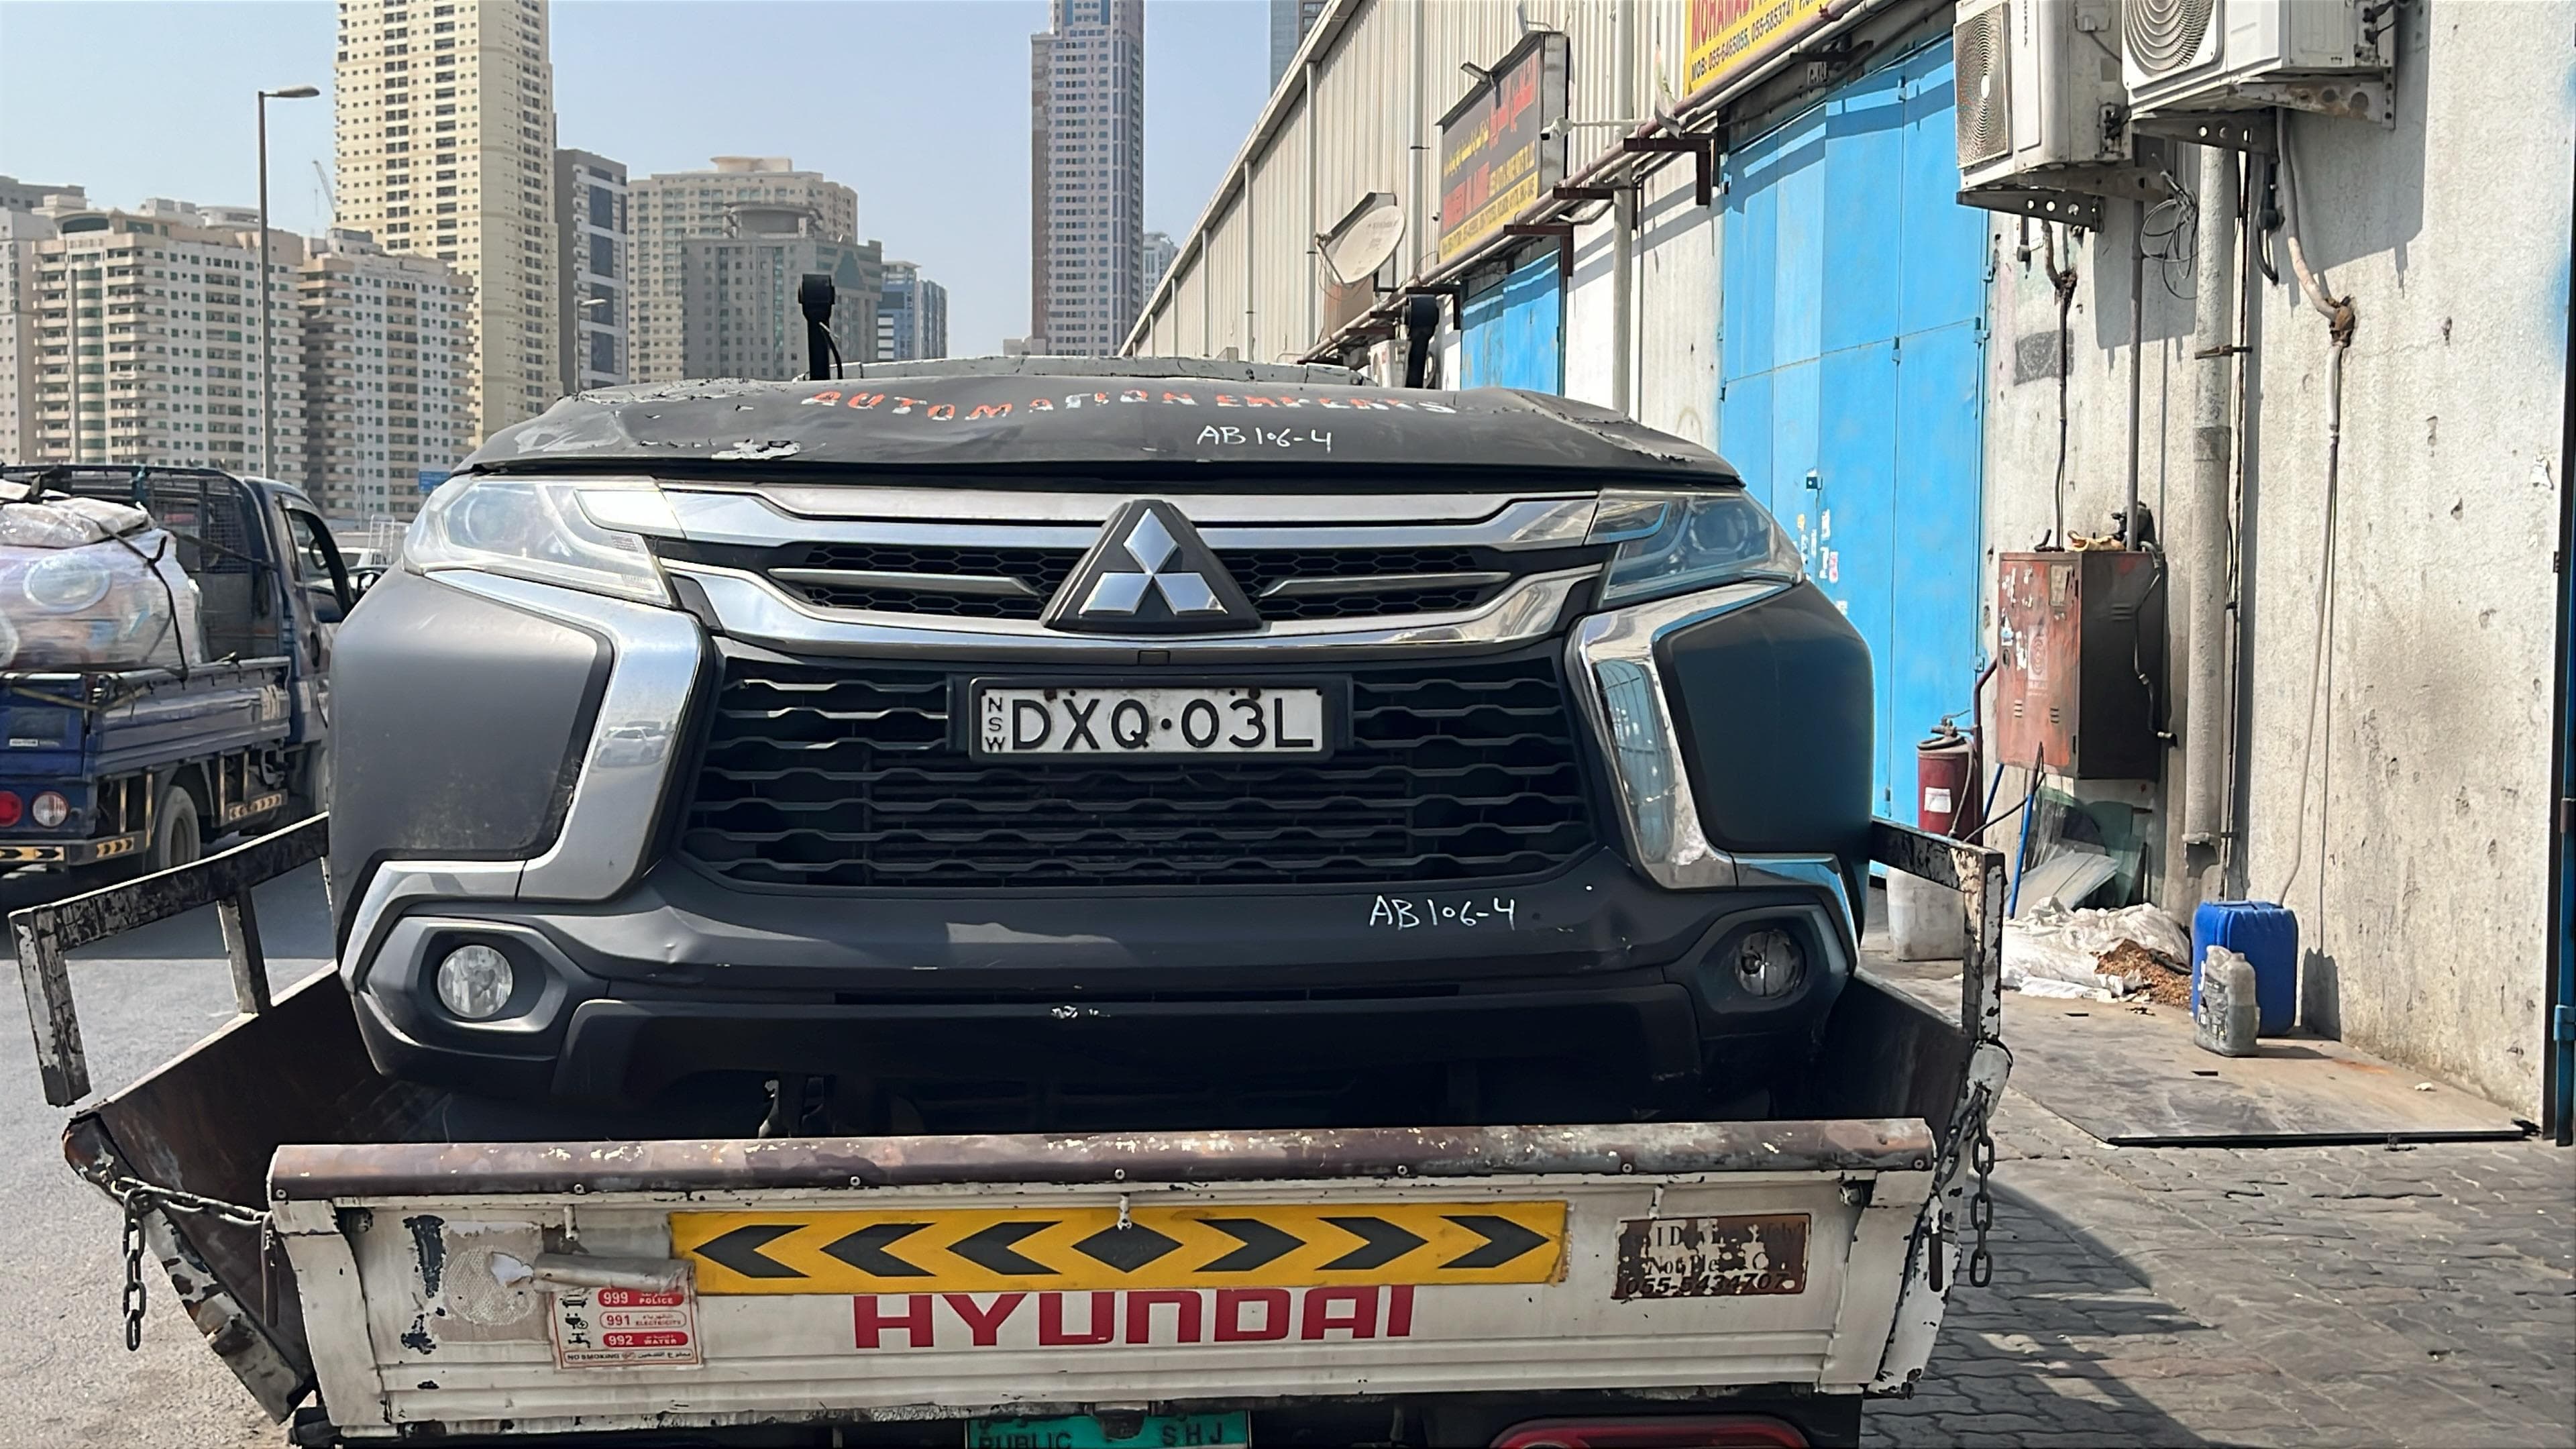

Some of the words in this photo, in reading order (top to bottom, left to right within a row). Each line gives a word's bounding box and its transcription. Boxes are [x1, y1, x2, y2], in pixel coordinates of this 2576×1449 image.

[1691, 0, 1749, 53] MOHAM
[603, 1291, 629, 1305] 999
[606, 1314, 631, 1326] 991
[854, 1285, 1414, 1348] HYUNDAI
[608, 1335, 634, 1346] 992
